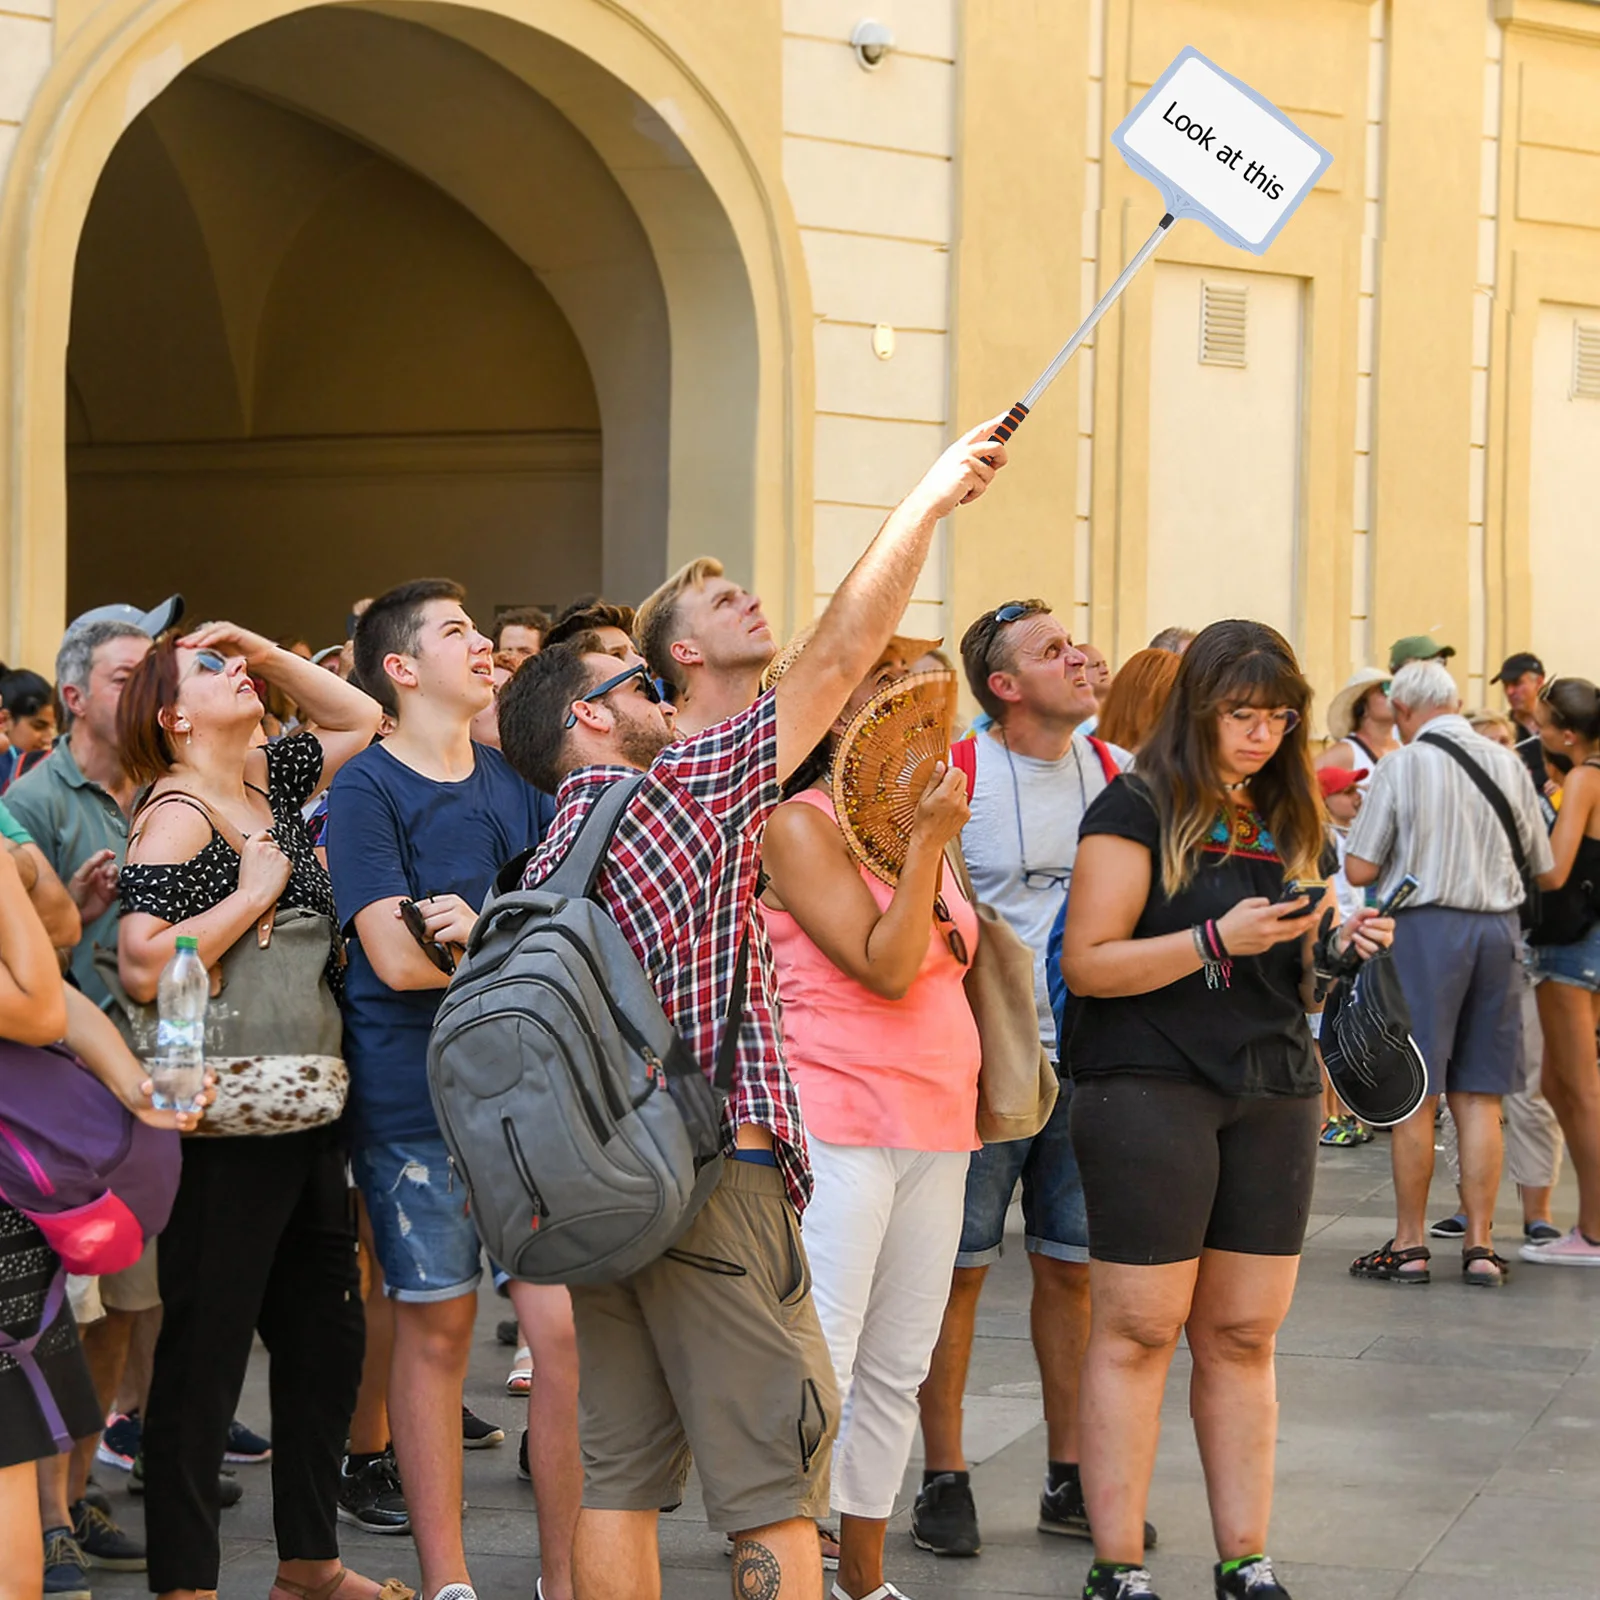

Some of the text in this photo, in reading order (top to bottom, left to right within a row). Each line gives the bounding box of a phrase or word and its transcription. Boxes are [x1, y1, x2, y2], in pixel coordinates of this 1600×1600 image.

[1162, 100, 1284, 200] Look at this
